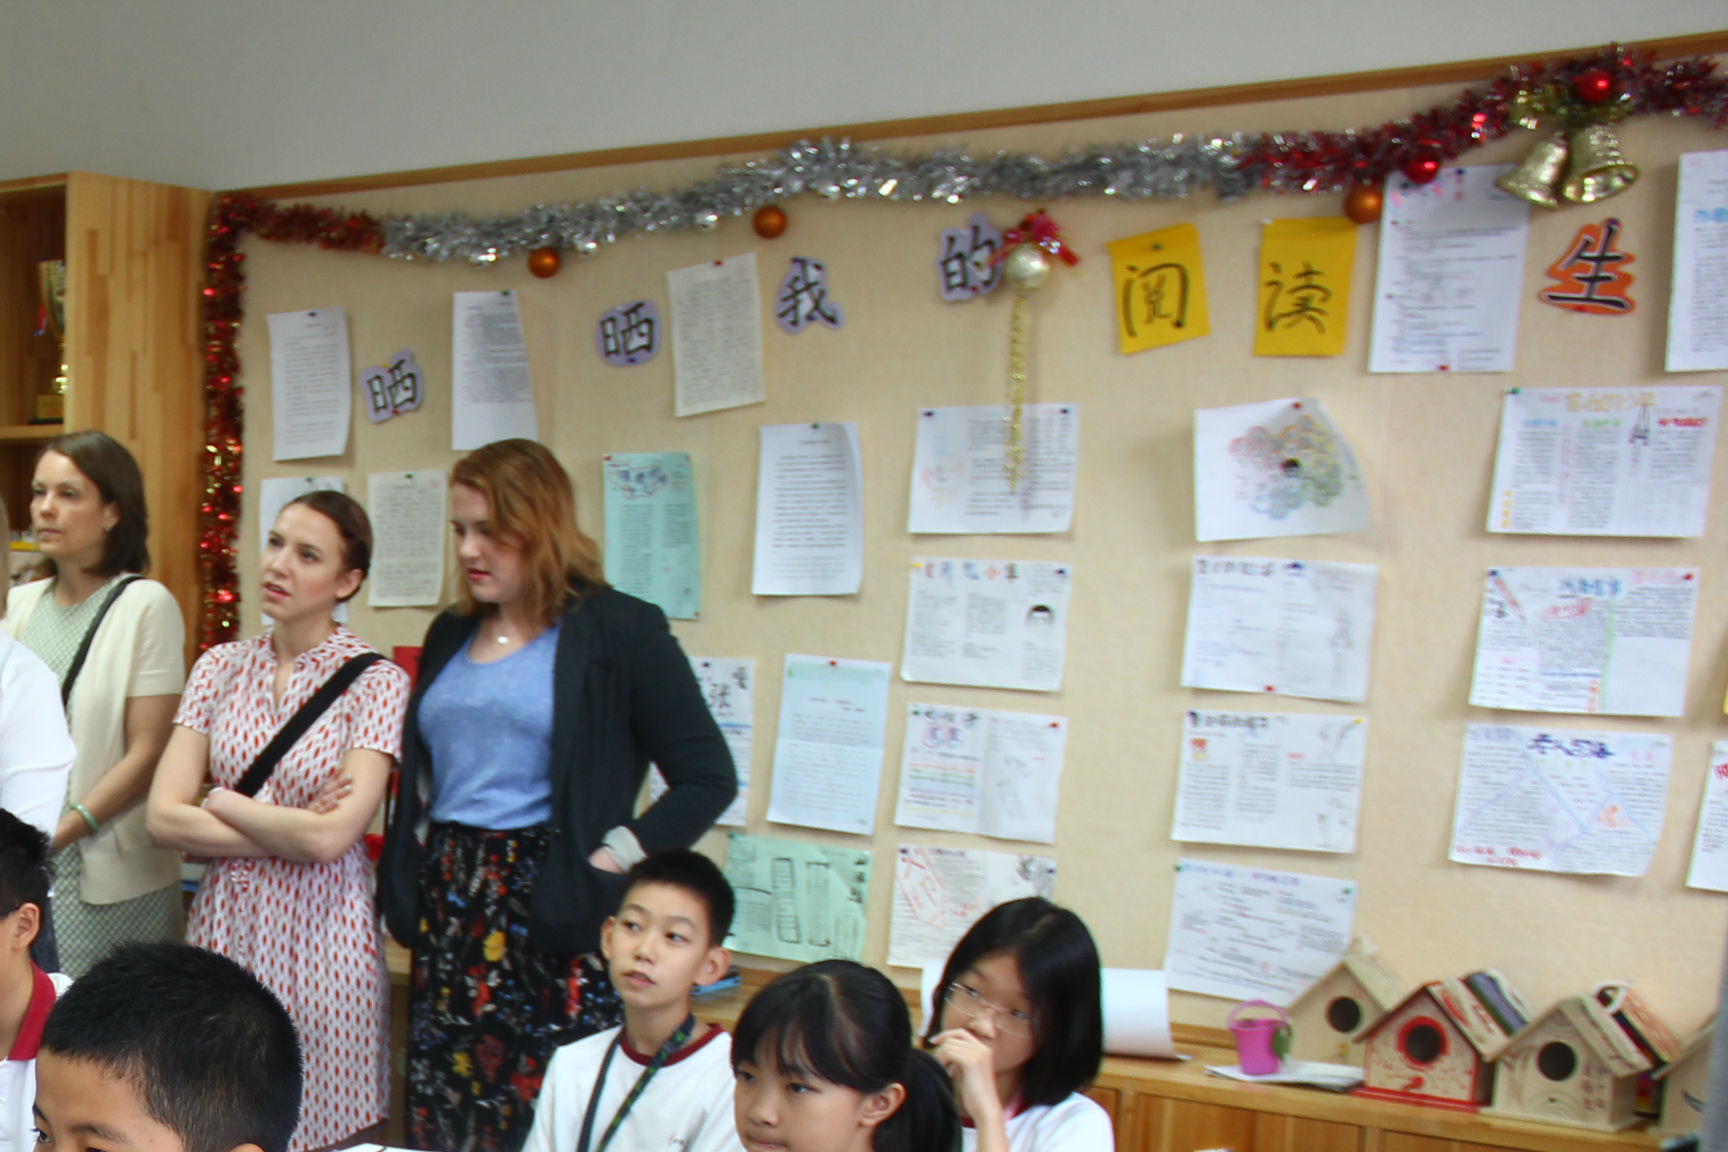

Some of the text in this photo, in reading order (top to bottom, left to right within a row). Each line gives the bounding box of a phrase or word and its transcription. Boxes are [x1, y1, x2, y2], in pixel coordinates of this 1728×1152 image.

[365, 359, 418, 415] 晒
[599, 301, 656, 358] 晒
[776, 257, 841, 329] 我
[940, 225, 999, 293] 的
[1122, 262, 1189, 338] 阅
[1262, 262, 1333, 335] 读
[1540, 218, 1631, 311] 生
